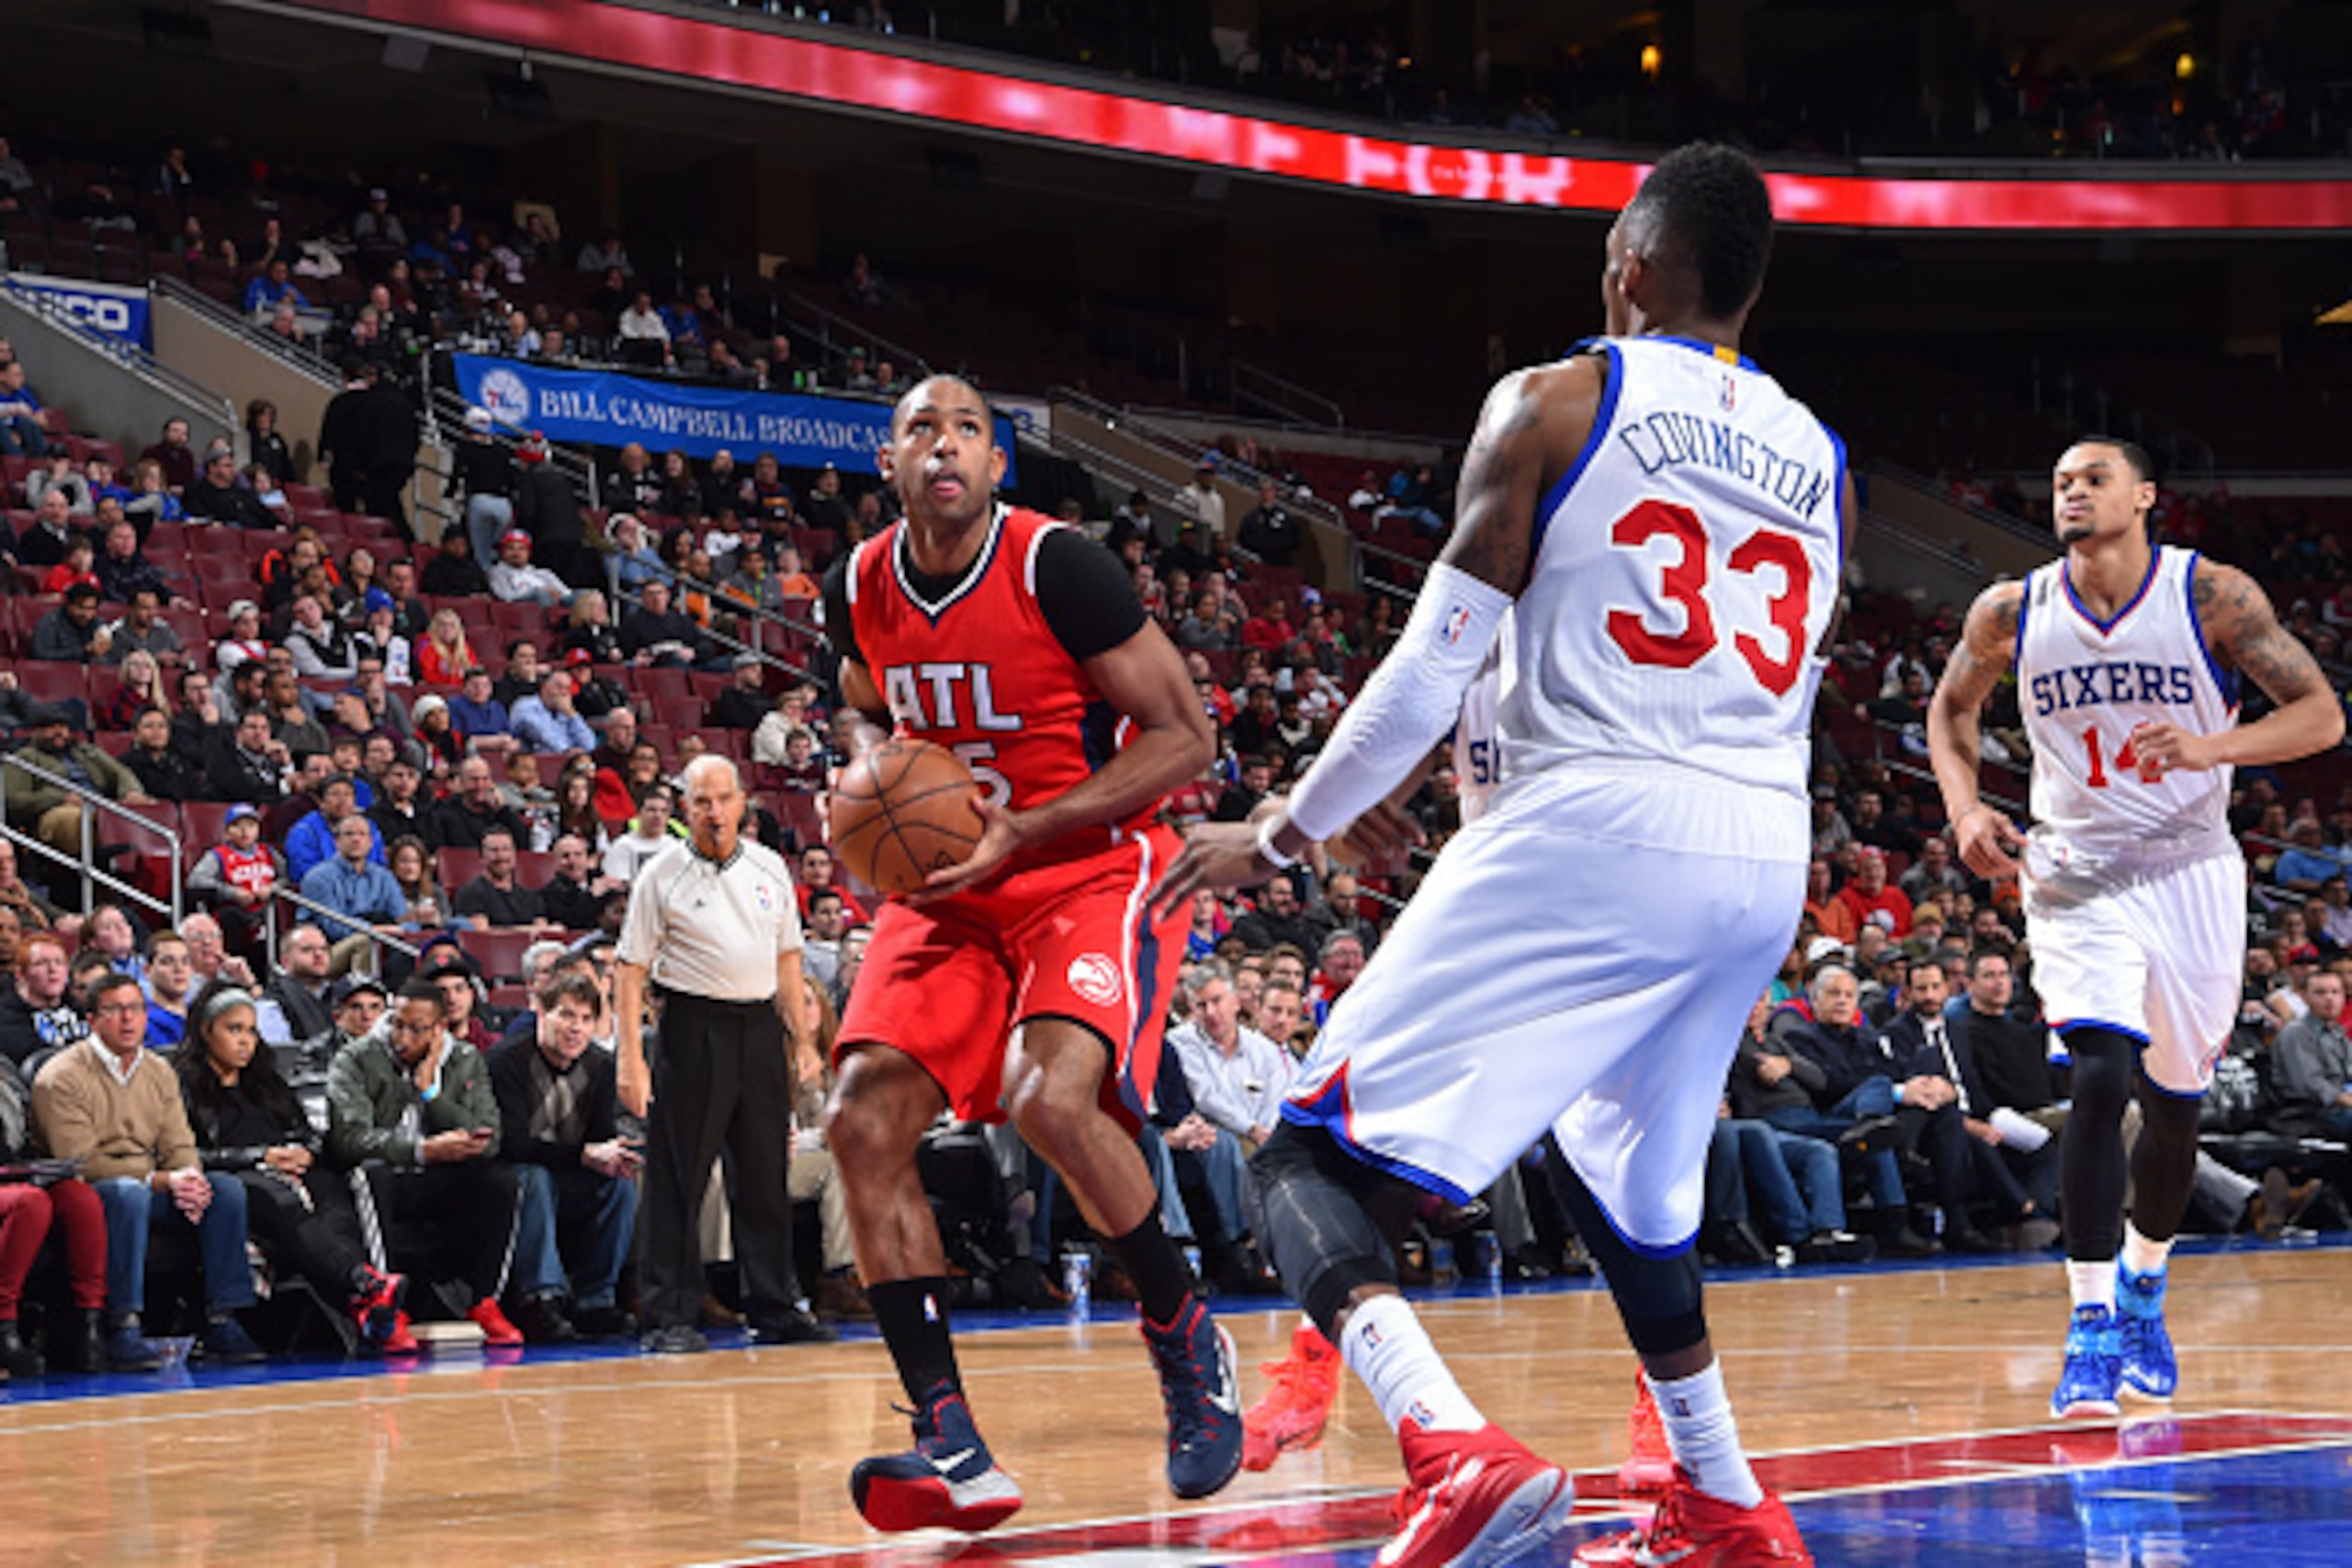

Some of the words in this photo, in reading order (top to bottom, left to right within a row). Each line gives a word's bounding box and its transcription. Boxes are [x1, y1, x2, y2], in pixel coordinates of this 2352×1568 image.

[539, 389, 607, 423] BILL
[608, 395, 754, 442] CAMPBELL
[1619, 411, 1830, 521] COVINGTON
[1604, 499, 1814, 699] 33
[885, 662, 1024, 731] ATL
[2031, 661, 2195, 716] SIXERS
